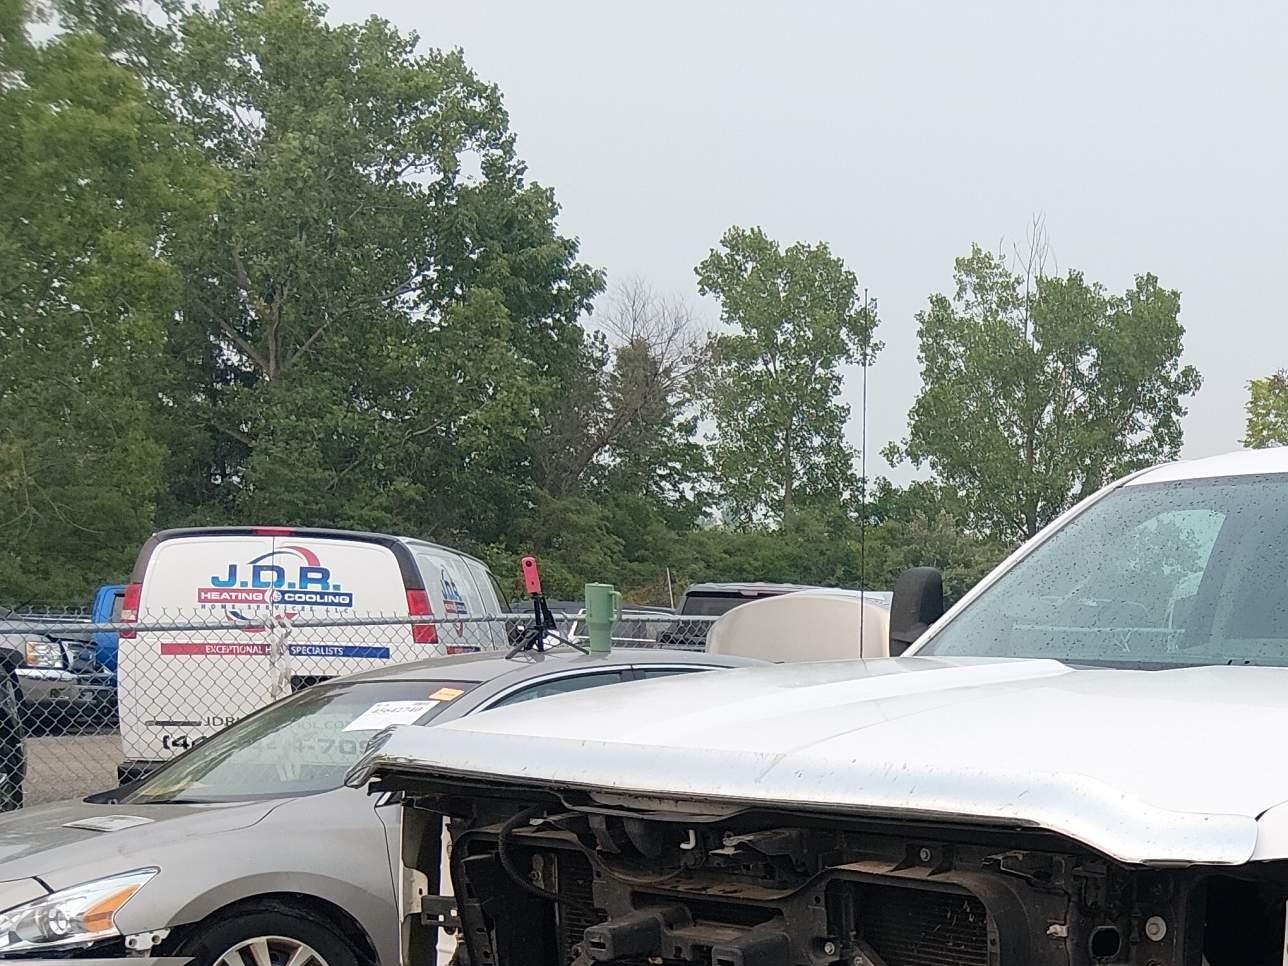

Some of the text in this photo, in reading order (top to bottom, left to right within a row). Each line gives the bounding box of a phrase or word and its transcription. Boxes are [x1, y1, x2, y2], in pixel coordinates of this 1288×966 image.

[211, 564, 341, 591] J.D.R.
[201, 591, 350, 604] HEATING COOLING
[205, 645, 263, 654] EXCEPTIONAL
[290, 646, 344, 656] SPECIALISTS
